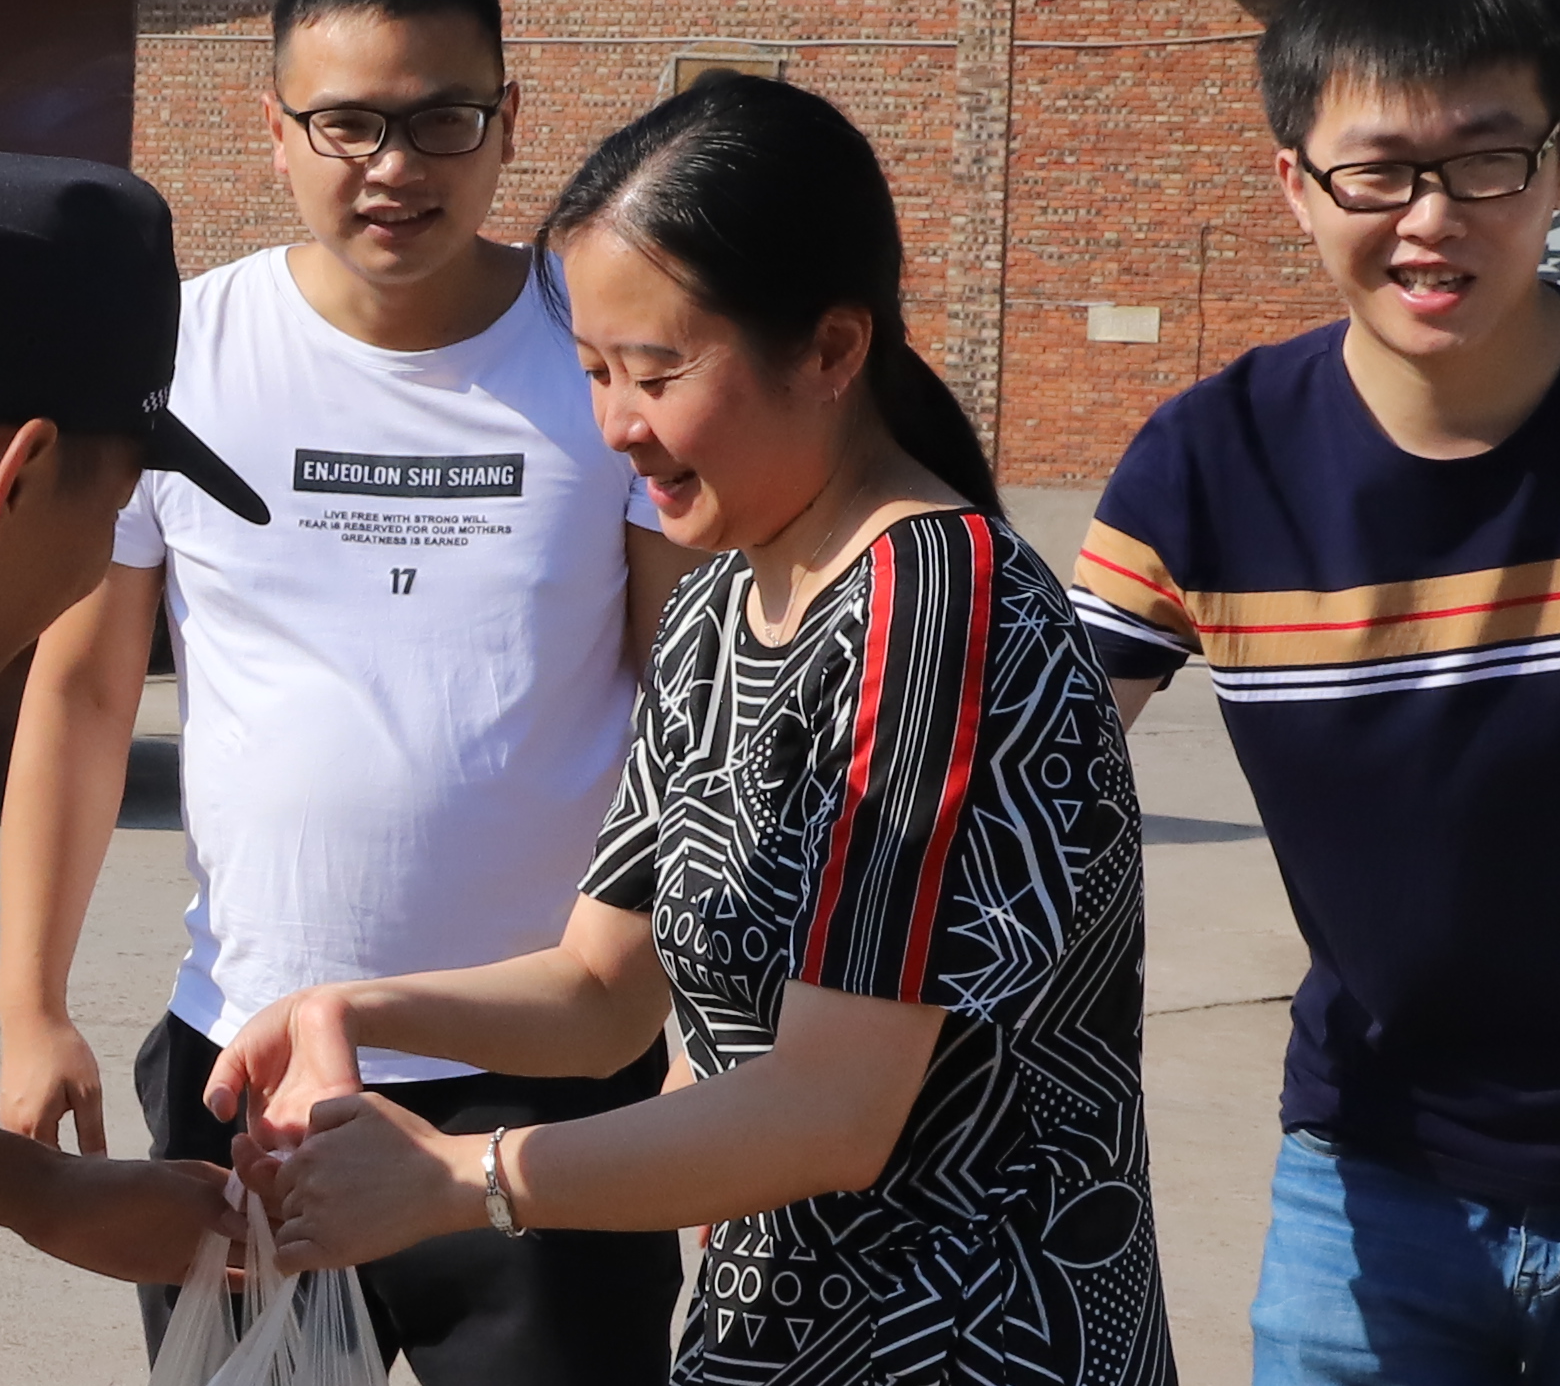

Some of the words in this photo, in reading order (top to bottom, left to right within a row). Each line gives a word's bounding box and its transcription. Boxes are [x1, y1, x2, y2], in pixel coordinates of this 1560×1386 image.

[303, 461, 401, 486] ENJEOLON
[407, 466, 441, 487] SHI
[447, 465, 514, 486] SHANG
[323, 510, 348, 521] LIVE
[350, 511, 379, 522] FREE
[382, 513, 410, 524] WITH
[414, 514, 459, 525] STRONG
[462, 514, 489, 525] WILL
[298, 519, 328, 531] FEAR
[343, 521, 403, 535] RESERVED
[406, 524, 429, 535] FOR
[431, 525, 456, 535] OUR
[458, 525, 512, 535] MOTHERS
[341, 533, 407, 546] GREATNESS
[410, 535, 421, 546] IS
[423, 536, 469, 547] EARNED
[389, 567, 418, 595] 17
